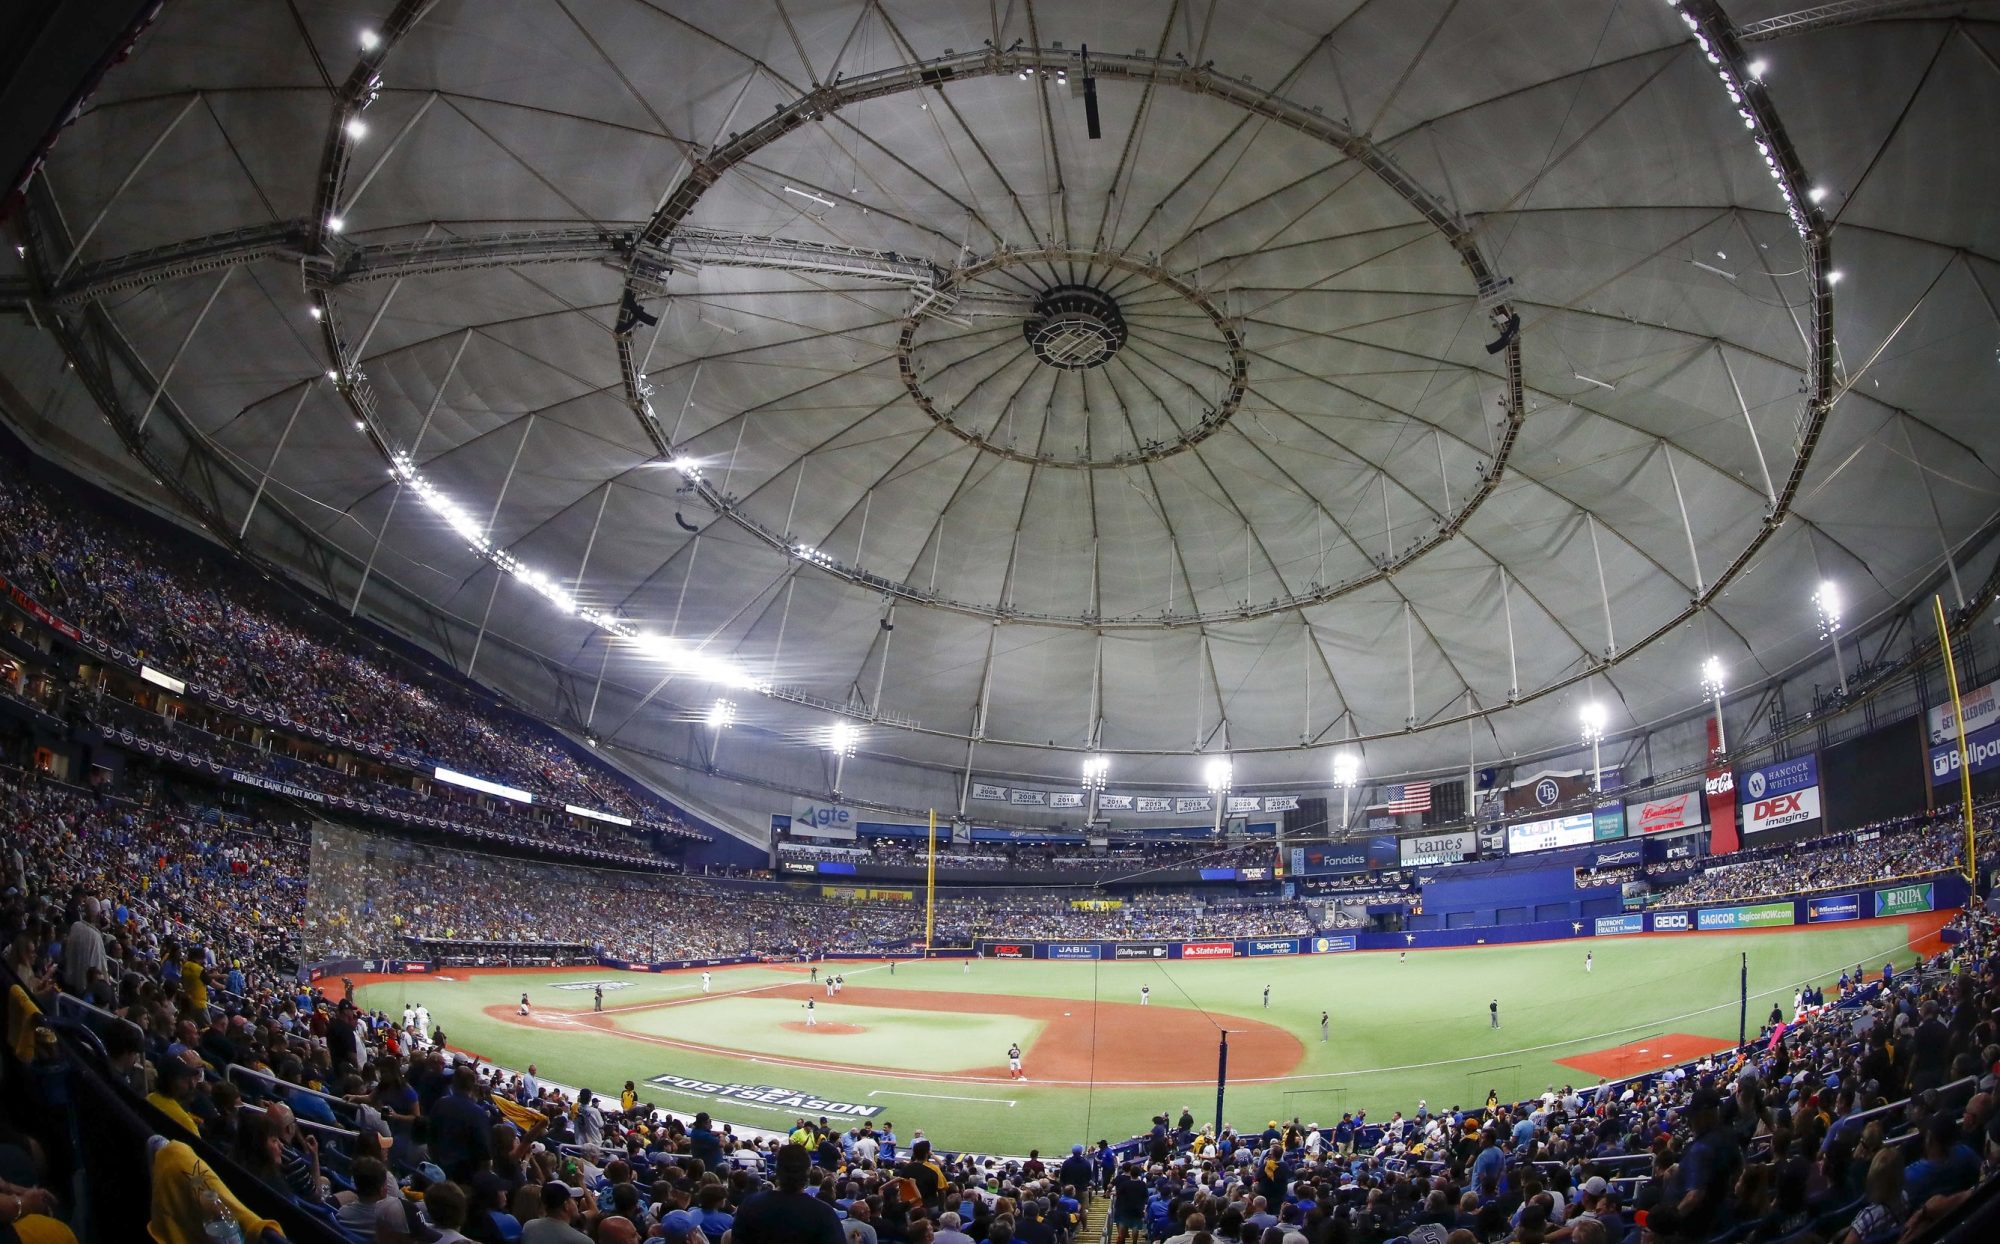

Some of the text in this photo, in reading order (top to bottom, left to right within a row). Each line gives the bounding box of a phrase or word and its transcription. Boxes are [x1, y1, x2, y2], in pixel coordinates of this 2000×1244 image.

[1942, 715, 1954, 730] GET
[1979, 698, 1996, 716] OVER
[1768, 762, 1809, 780] HANCOCK
[232, 772, 324, 802] REPUBLIC BANK DRAFT ROOM
[1769, 772, 1809, 790] WHITNEY
[1540, 784, 1556, 801] TB
[1753, 792, 1803, 821] DEX
[818, 807, 849, 825] gte
[1765, 810, 1810, 827] imaging
[1414, 838, 1462, 854] kanes
[1323, 854, 1365, 866] Fanatics
[1896, 888, 1924, 905] RIPA
[1598, 919, 1625, 927] BAYFRONT
[1655, 916, 1687, 928] GEICO
[1701, 909, 1792, 925] SAGICOR SagicorNOW.com
[1256, 942, 1291, 950] Spectrum
[652, 1075, 879, 1116] POSTSEASON
